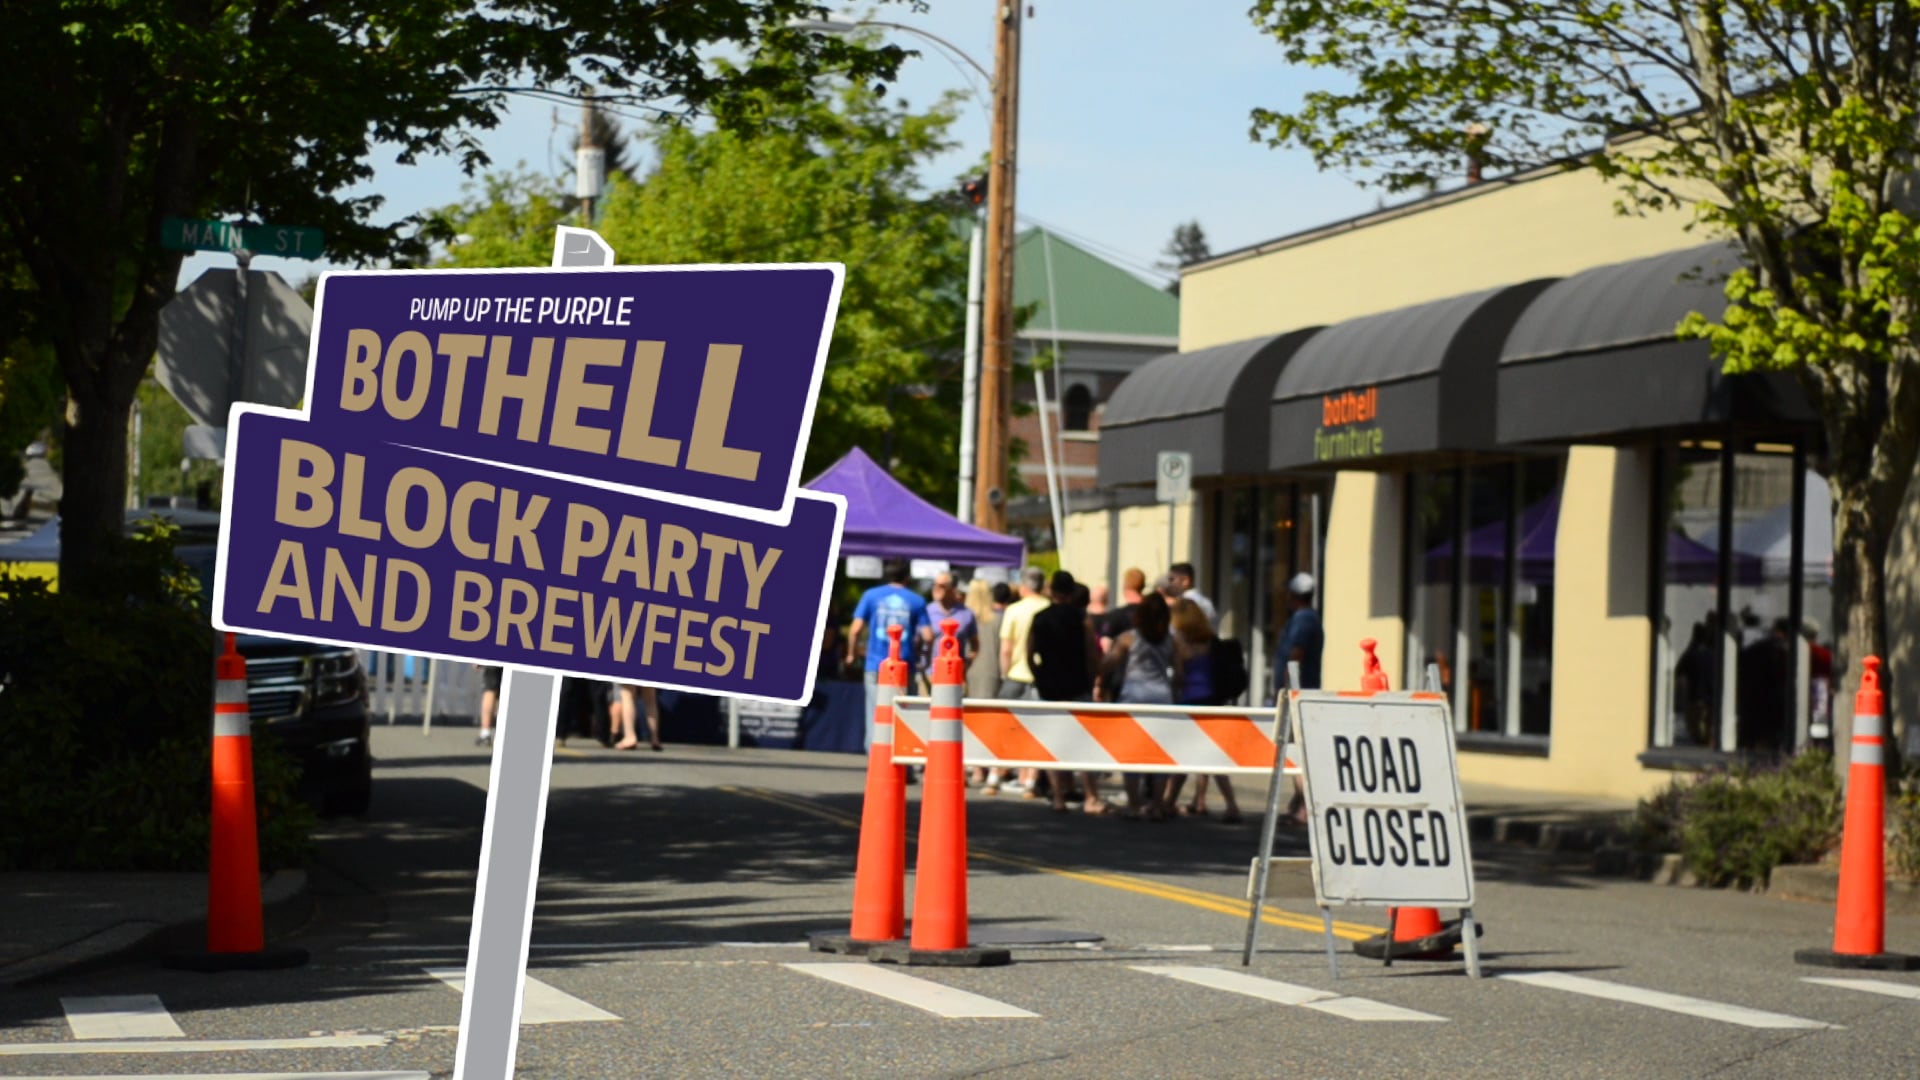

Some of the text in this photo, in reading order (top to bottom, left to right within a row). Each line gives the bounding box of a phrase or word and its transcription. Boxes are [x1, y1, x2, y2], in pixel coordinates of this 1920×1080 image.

[181, 222, 305, 253] MAIN ST
[1322, 387, 1378, 427] bothell
[1314, 426, 1384, 461] furniture
[1333, 735, 1421, 794] ROAD
[1325, 807, 1450, 867] CLOSED
